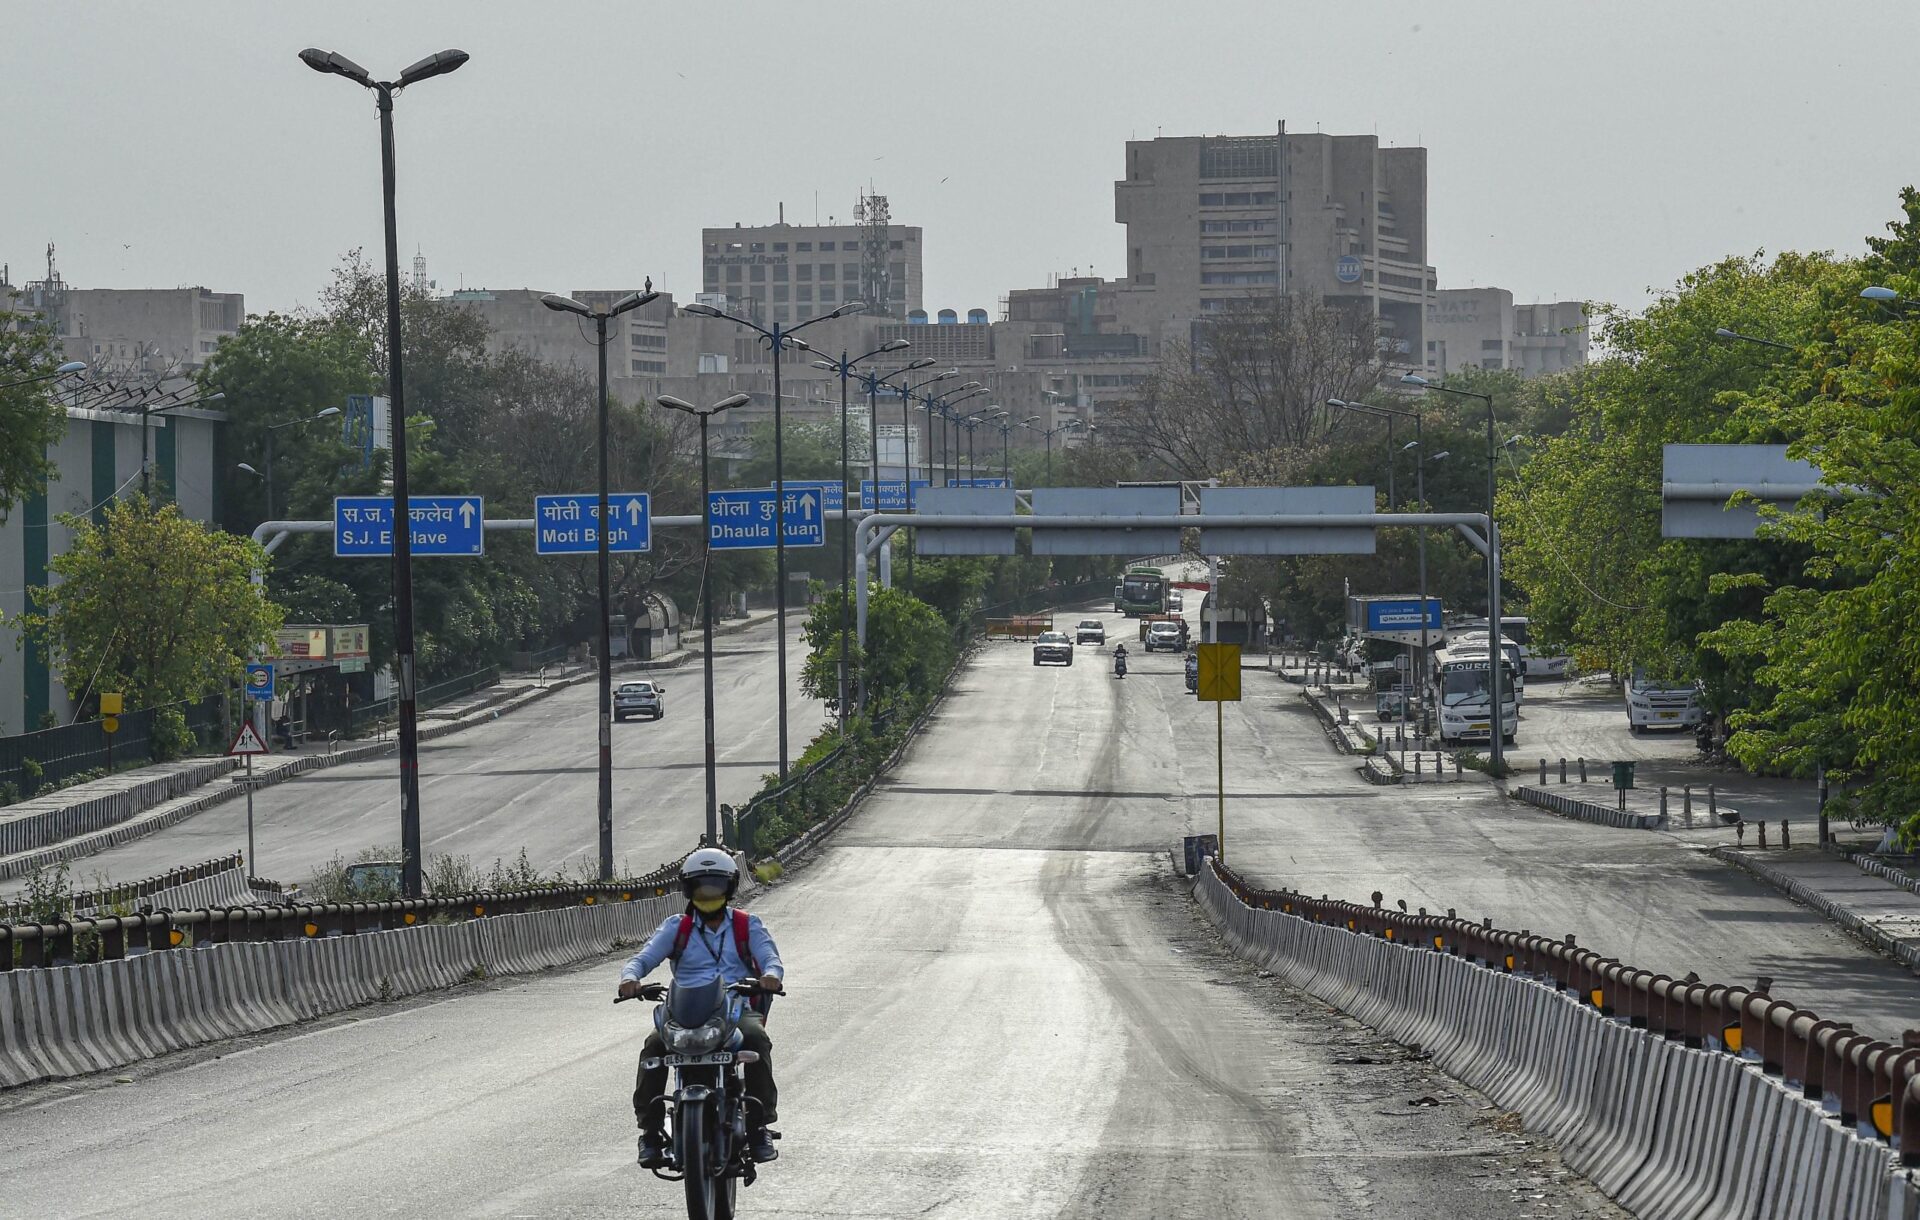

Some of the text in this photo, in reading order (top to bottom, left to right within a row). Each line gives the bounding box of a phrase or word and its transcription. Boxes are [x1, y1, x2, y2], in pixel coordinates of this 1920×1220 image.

[757, 254, 788, 264] Bank
[542, 500, 580, 521] मोती
[711, 496, 750, 517] धौला
[342, 507, 387, 523] स.ज.
[342, 530, 448, 545] S.J. Elave
[542, 527, 629, 545] Moti Bgh
[711, 523, 770, 539] Dhaula
